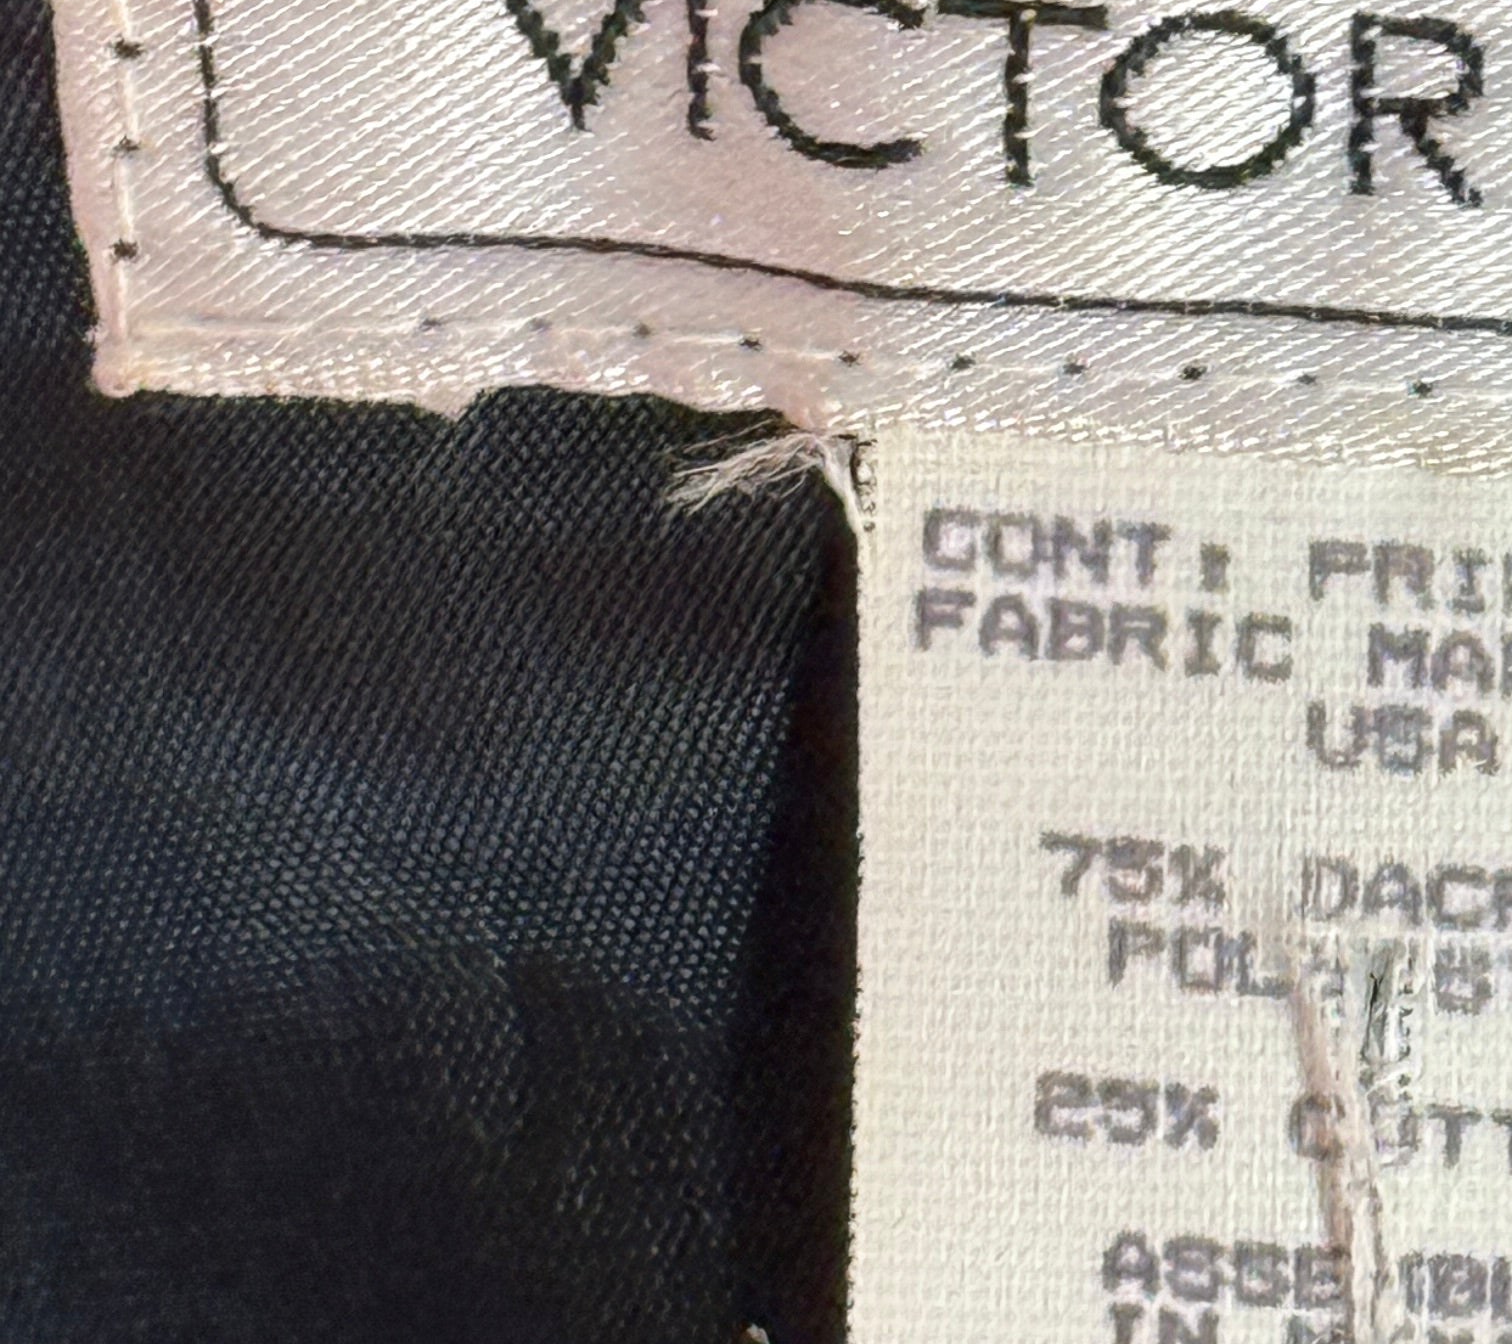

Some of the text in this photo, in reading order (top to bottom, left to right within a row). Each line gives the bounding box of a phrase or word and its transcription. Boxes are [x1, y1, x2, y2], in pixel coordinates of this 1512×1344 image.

[915, 587, 1293, 682] FABRIC
[1306, 700, 1500, 776] USA
[1037, 830, 1228, 911] 75%
[1032, 1071, 1221, 1150] 25%
